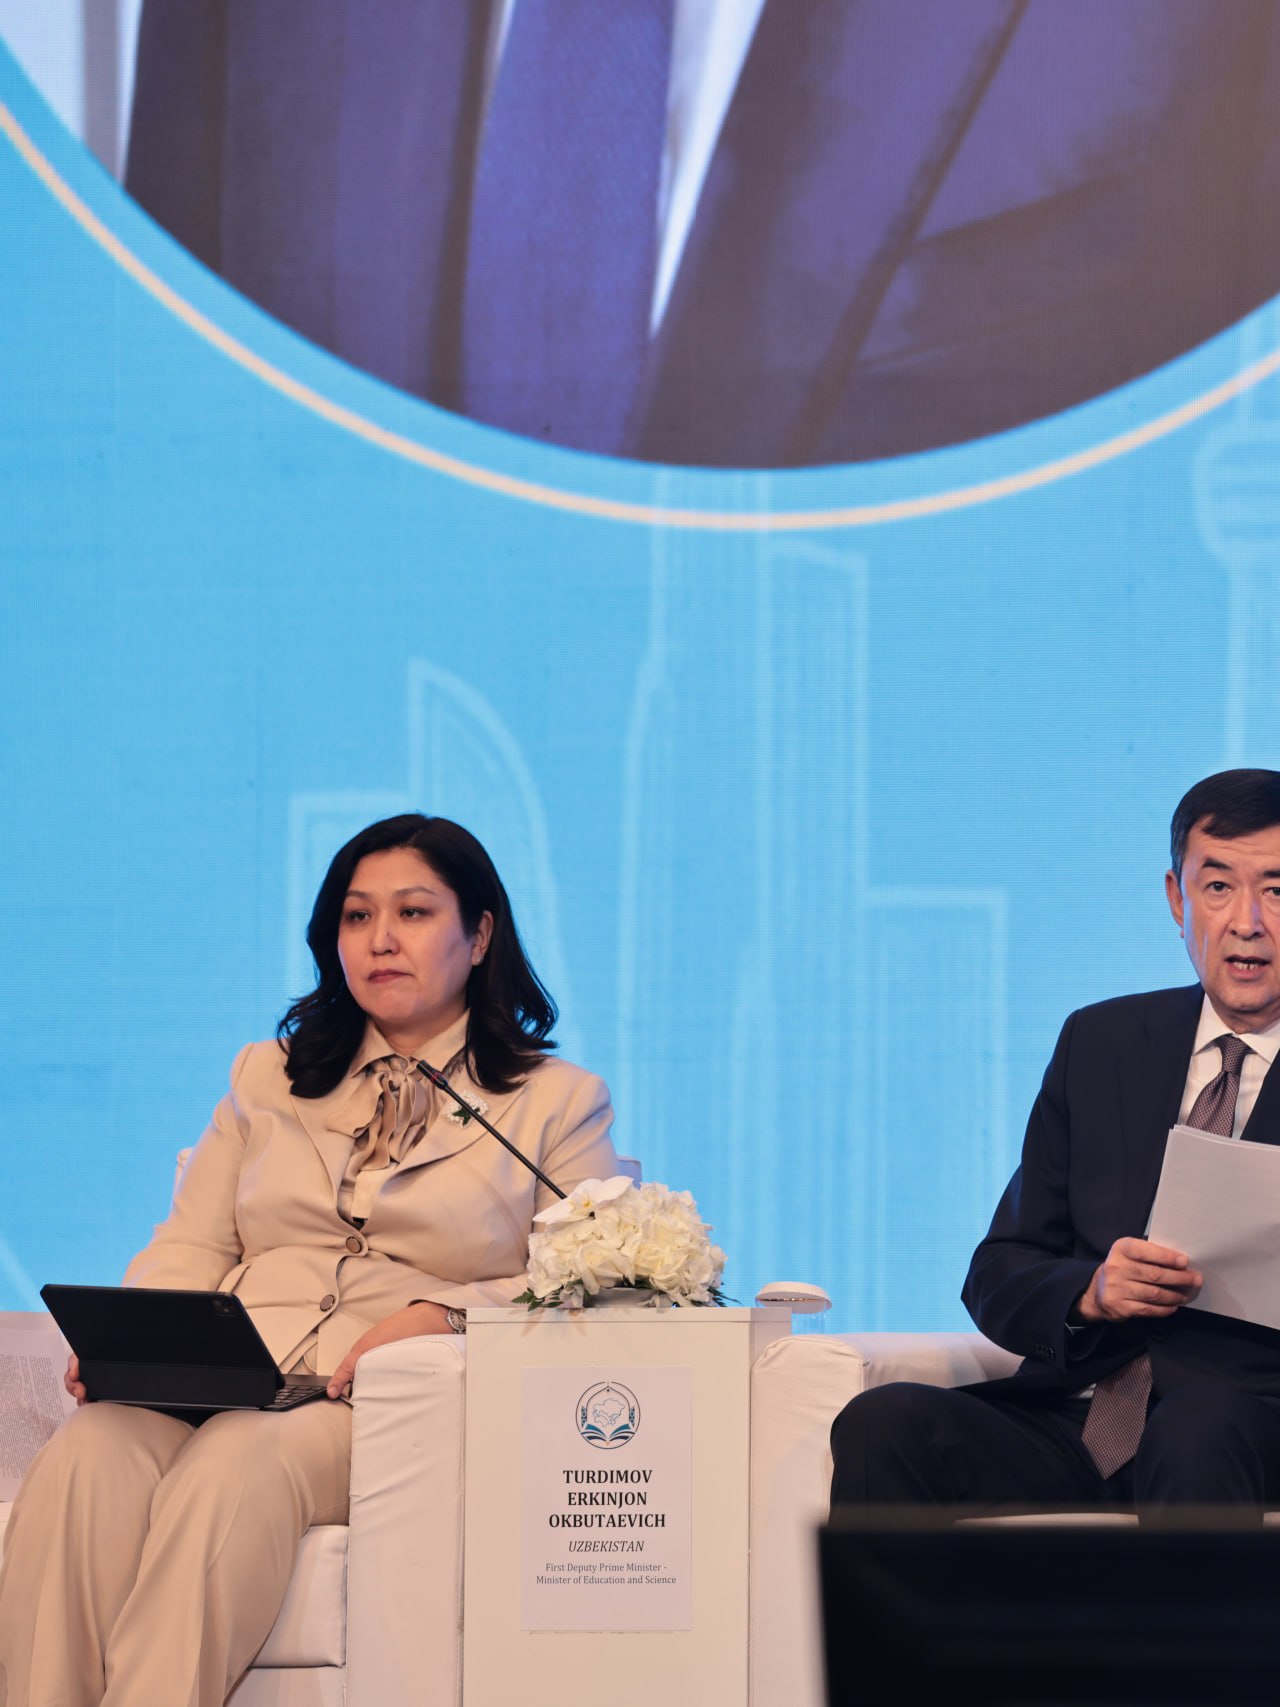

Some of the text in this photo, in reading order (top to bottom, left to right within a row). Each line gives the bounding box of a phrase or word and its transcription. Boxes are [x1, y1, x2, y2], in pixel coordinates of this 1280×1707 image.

[562, 1469, 653, 1484] TURDIMOV
[567, 1491, 648, 1509] ERKINJON
[548, 1513, 667, 1528] OKBUTAEVICH
[568, 1540, 645, 1553] UZBEKISTAN
[545, 1562, 565, 1572] First
[567, 1562, 598, 1574] Deputy
[599, 1562, 625, 1572] Prime
[626, 1562, 662, 1572] Minister
[536, 1575, 677, 1585] Minister of Education and Science
